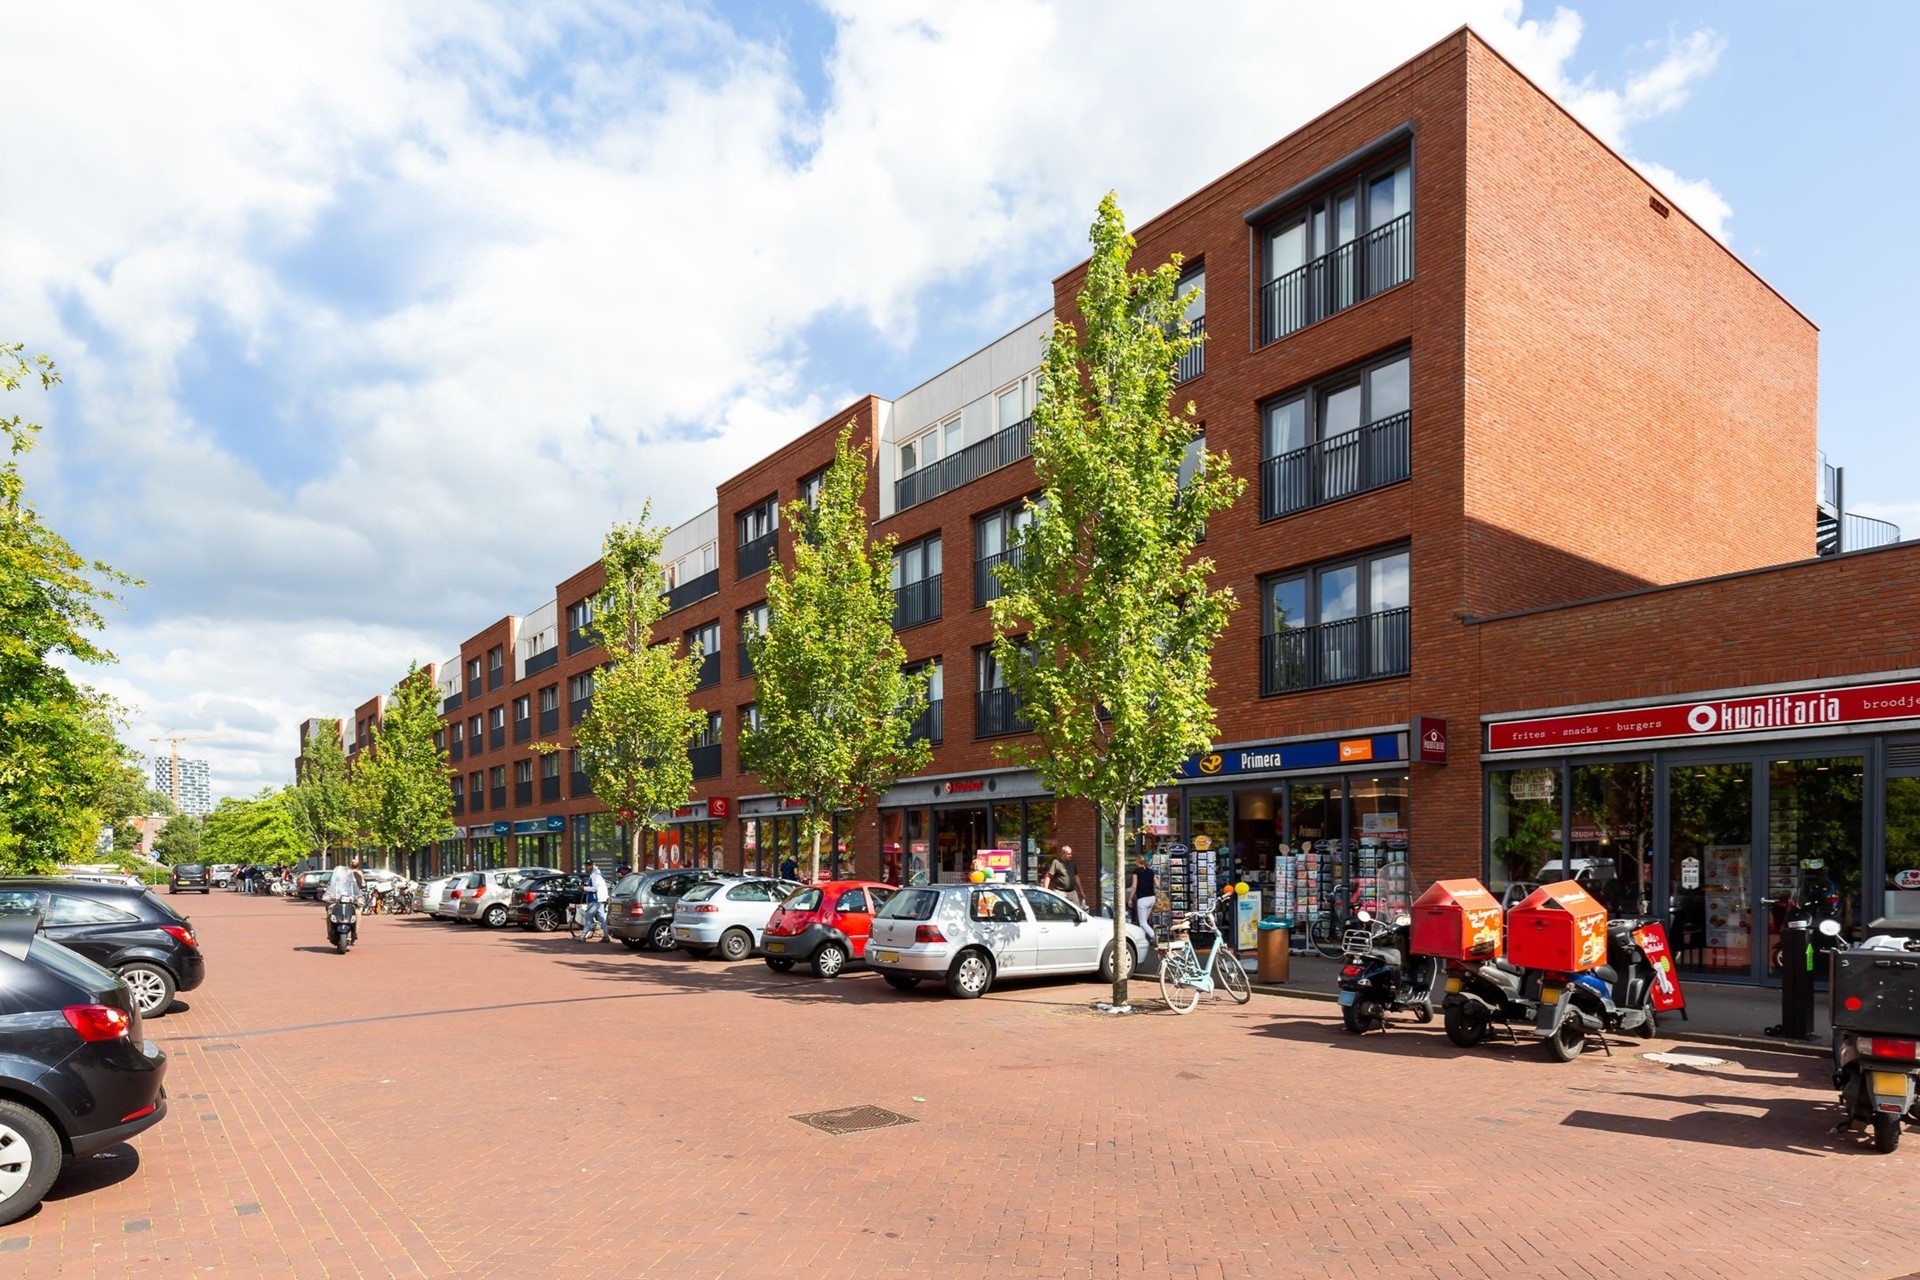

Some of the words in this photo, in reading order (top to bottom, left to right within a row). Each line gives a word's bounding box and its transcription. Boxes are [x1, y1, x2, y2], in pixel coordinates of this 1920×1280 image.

[1721, 693, 1840, 731] kwalitaria
[1512, 731, 1546, 741] frites
[1562, 725, 1599, 736] snacks
[1617, 720, 1662, 732] burgers
[1241, 752, 1282, 769] Primera
